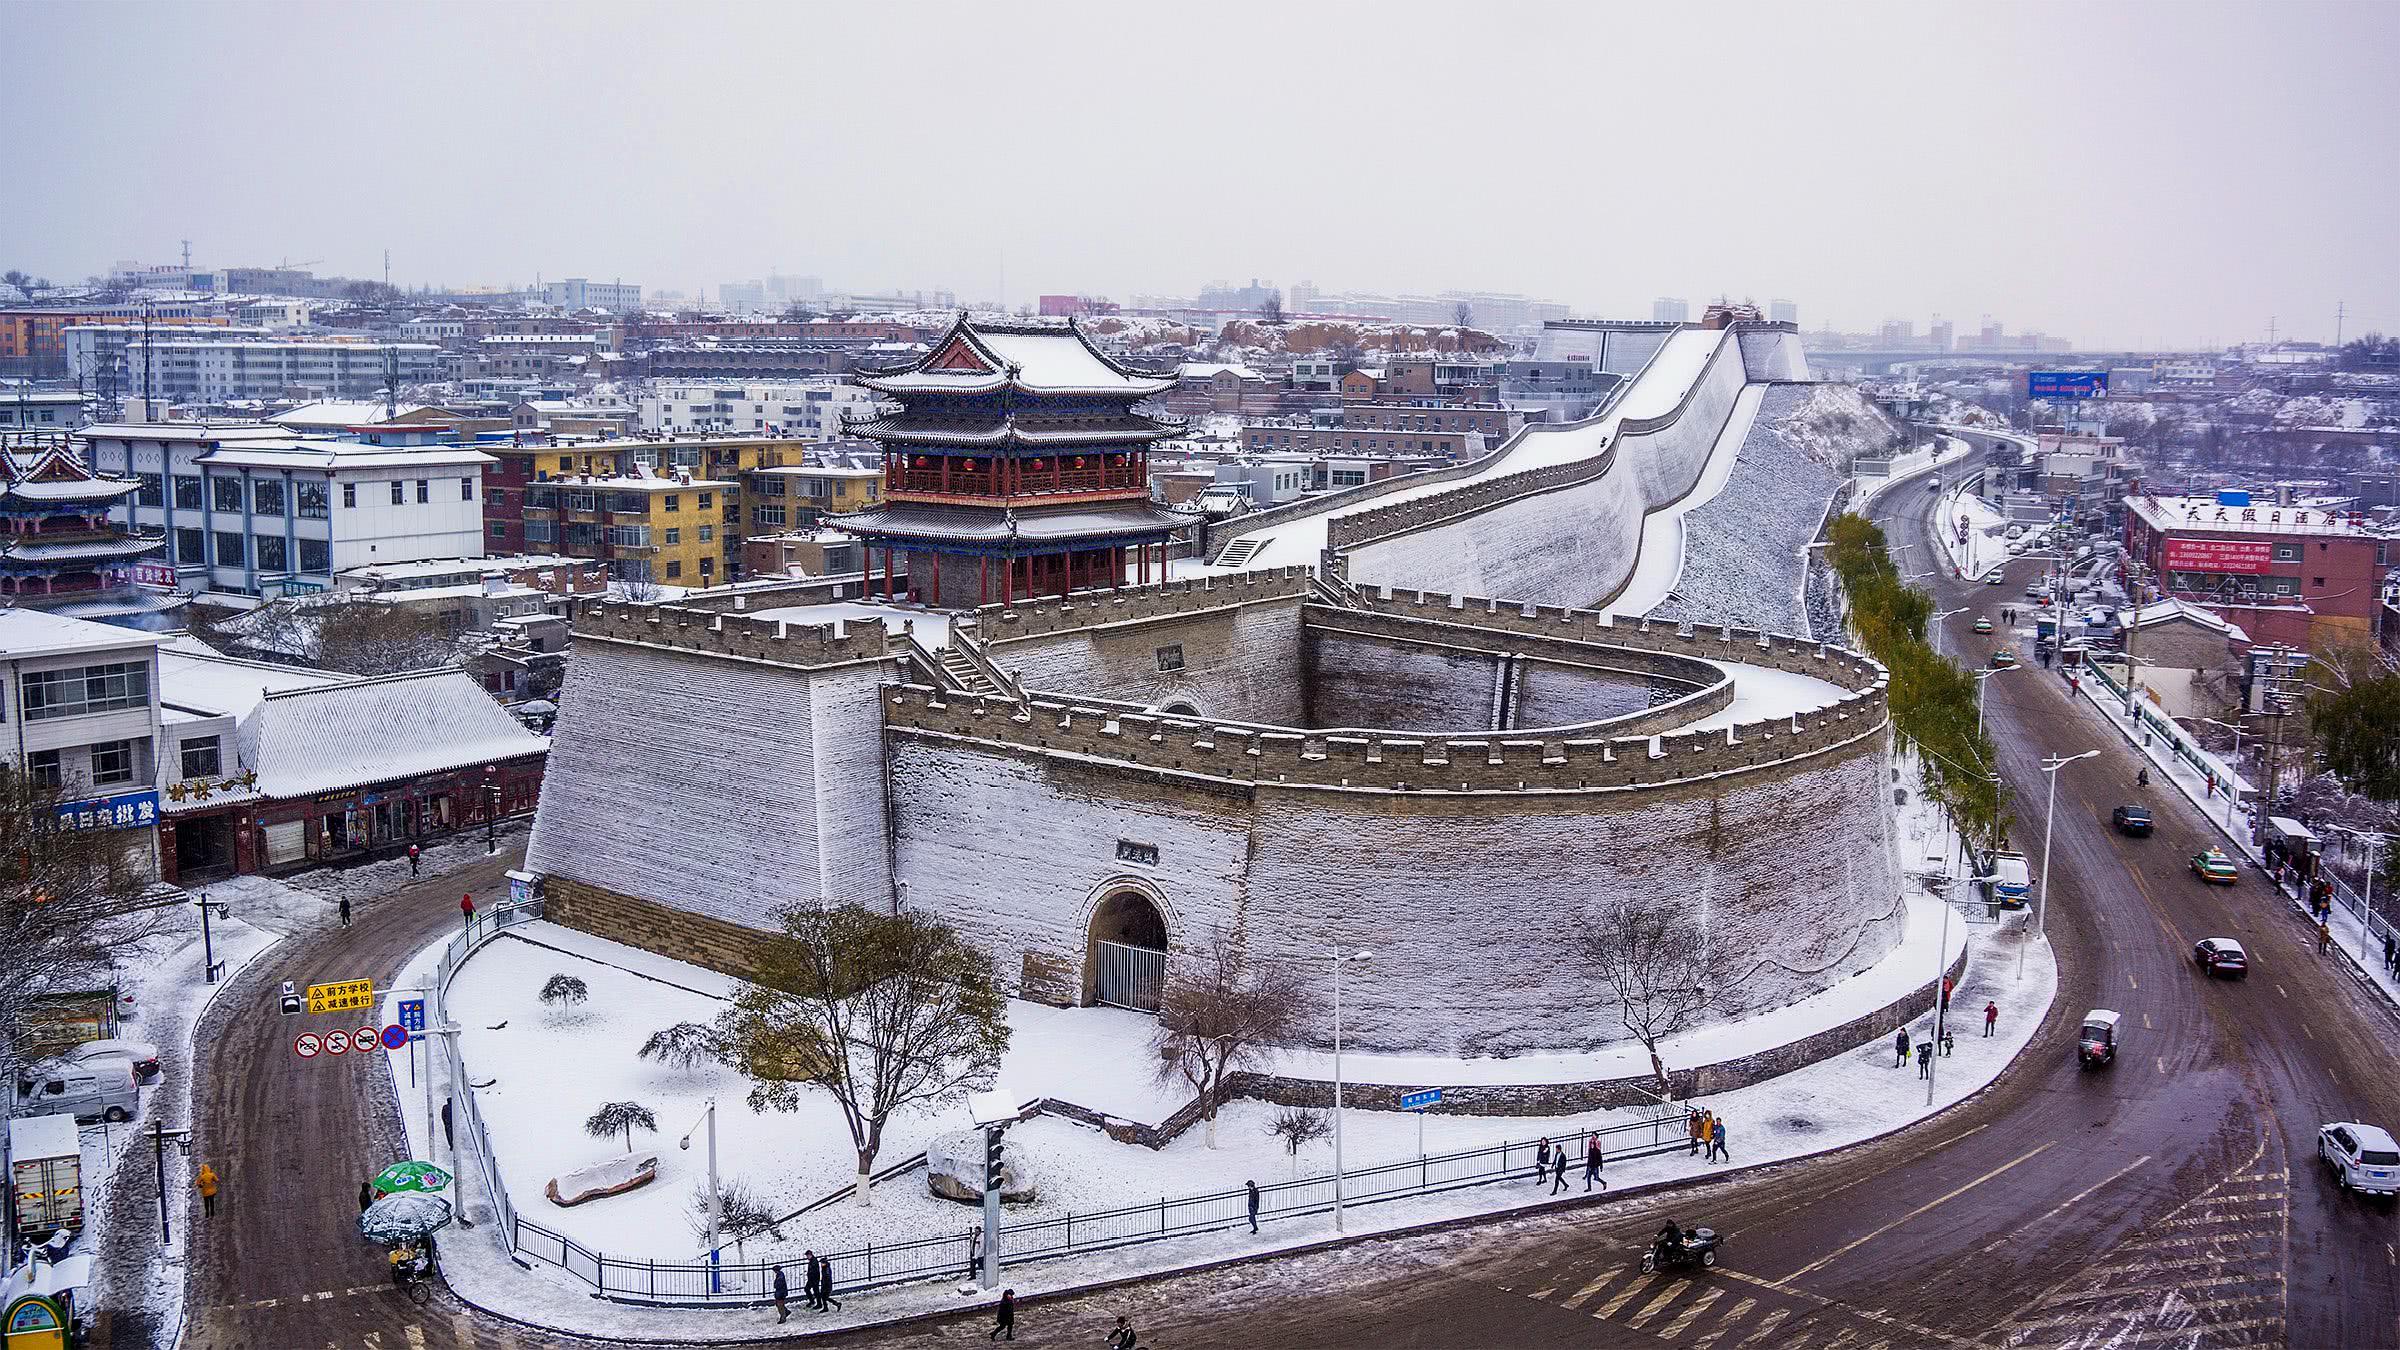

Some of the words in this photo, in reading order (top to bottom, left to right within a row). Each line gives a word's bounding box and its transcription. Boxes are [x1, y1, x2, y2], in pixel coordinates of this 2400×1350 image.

[326, 982, 369, 997] 前方学校
[328, 997, 370, 1009] 减速慢行
